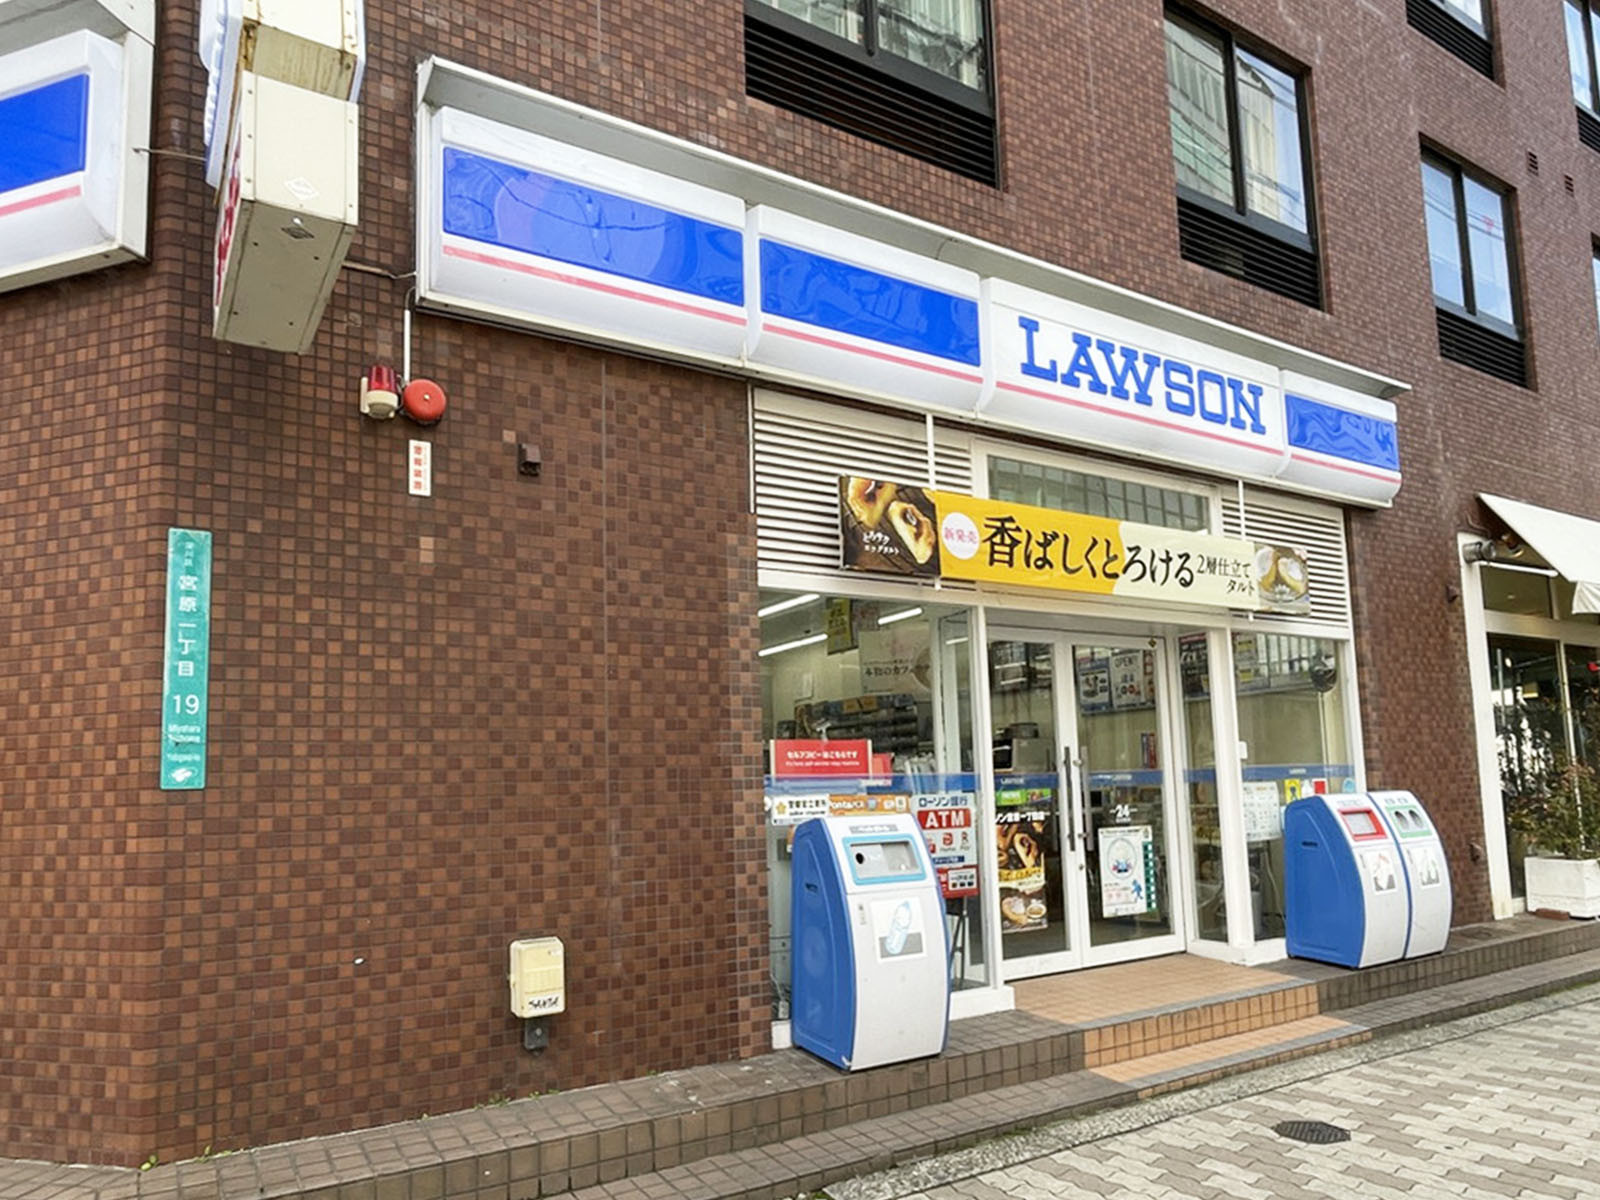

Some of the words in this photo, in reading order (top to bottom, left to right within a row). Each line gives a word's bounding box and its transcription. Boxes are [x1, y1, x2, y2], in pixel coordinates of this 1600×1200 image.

[1018, 316, 1266, 435] LAWSON
[944, 526, 978, 544] 新発売
[982, 515, 1195, 588] 香ばしくとろける
[1196, 554, 1252, 579] 2層仕立て
[1226, 581, 1256, 596] タルト
[178, 575, 199, 678] 宮原一丁目
[173, 694, 200, 715] 19
[919, 796, 968, 808] ローソン銀行
[1115, 804, 1131, 818] 24
[925, 810, 965, 828] ATM
